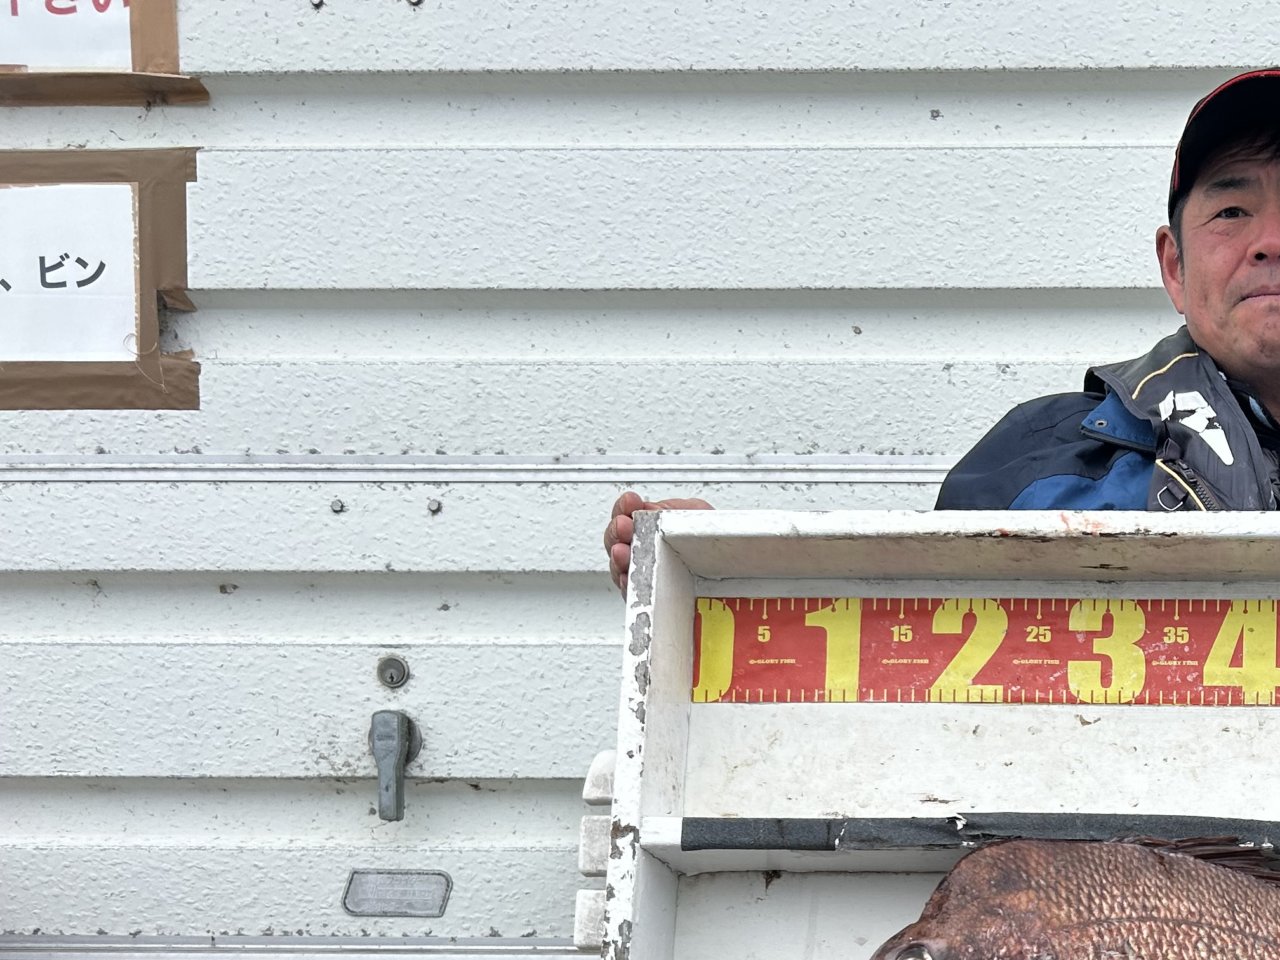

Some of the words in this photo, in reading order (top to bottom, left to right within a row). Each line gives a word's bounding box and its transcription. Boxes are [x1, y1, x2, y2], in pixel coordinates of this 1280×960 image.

[757, 626, 771, 642] 5
[805, 598, 861, 702] 1
[890, 625, 913, 642] 15
[930, 598, 1009, 703] 2
[1026, 626, 1051, 643] 25
[1067, 599, 1146, 704] 3
[1163, 627, 1189, 644] 35
